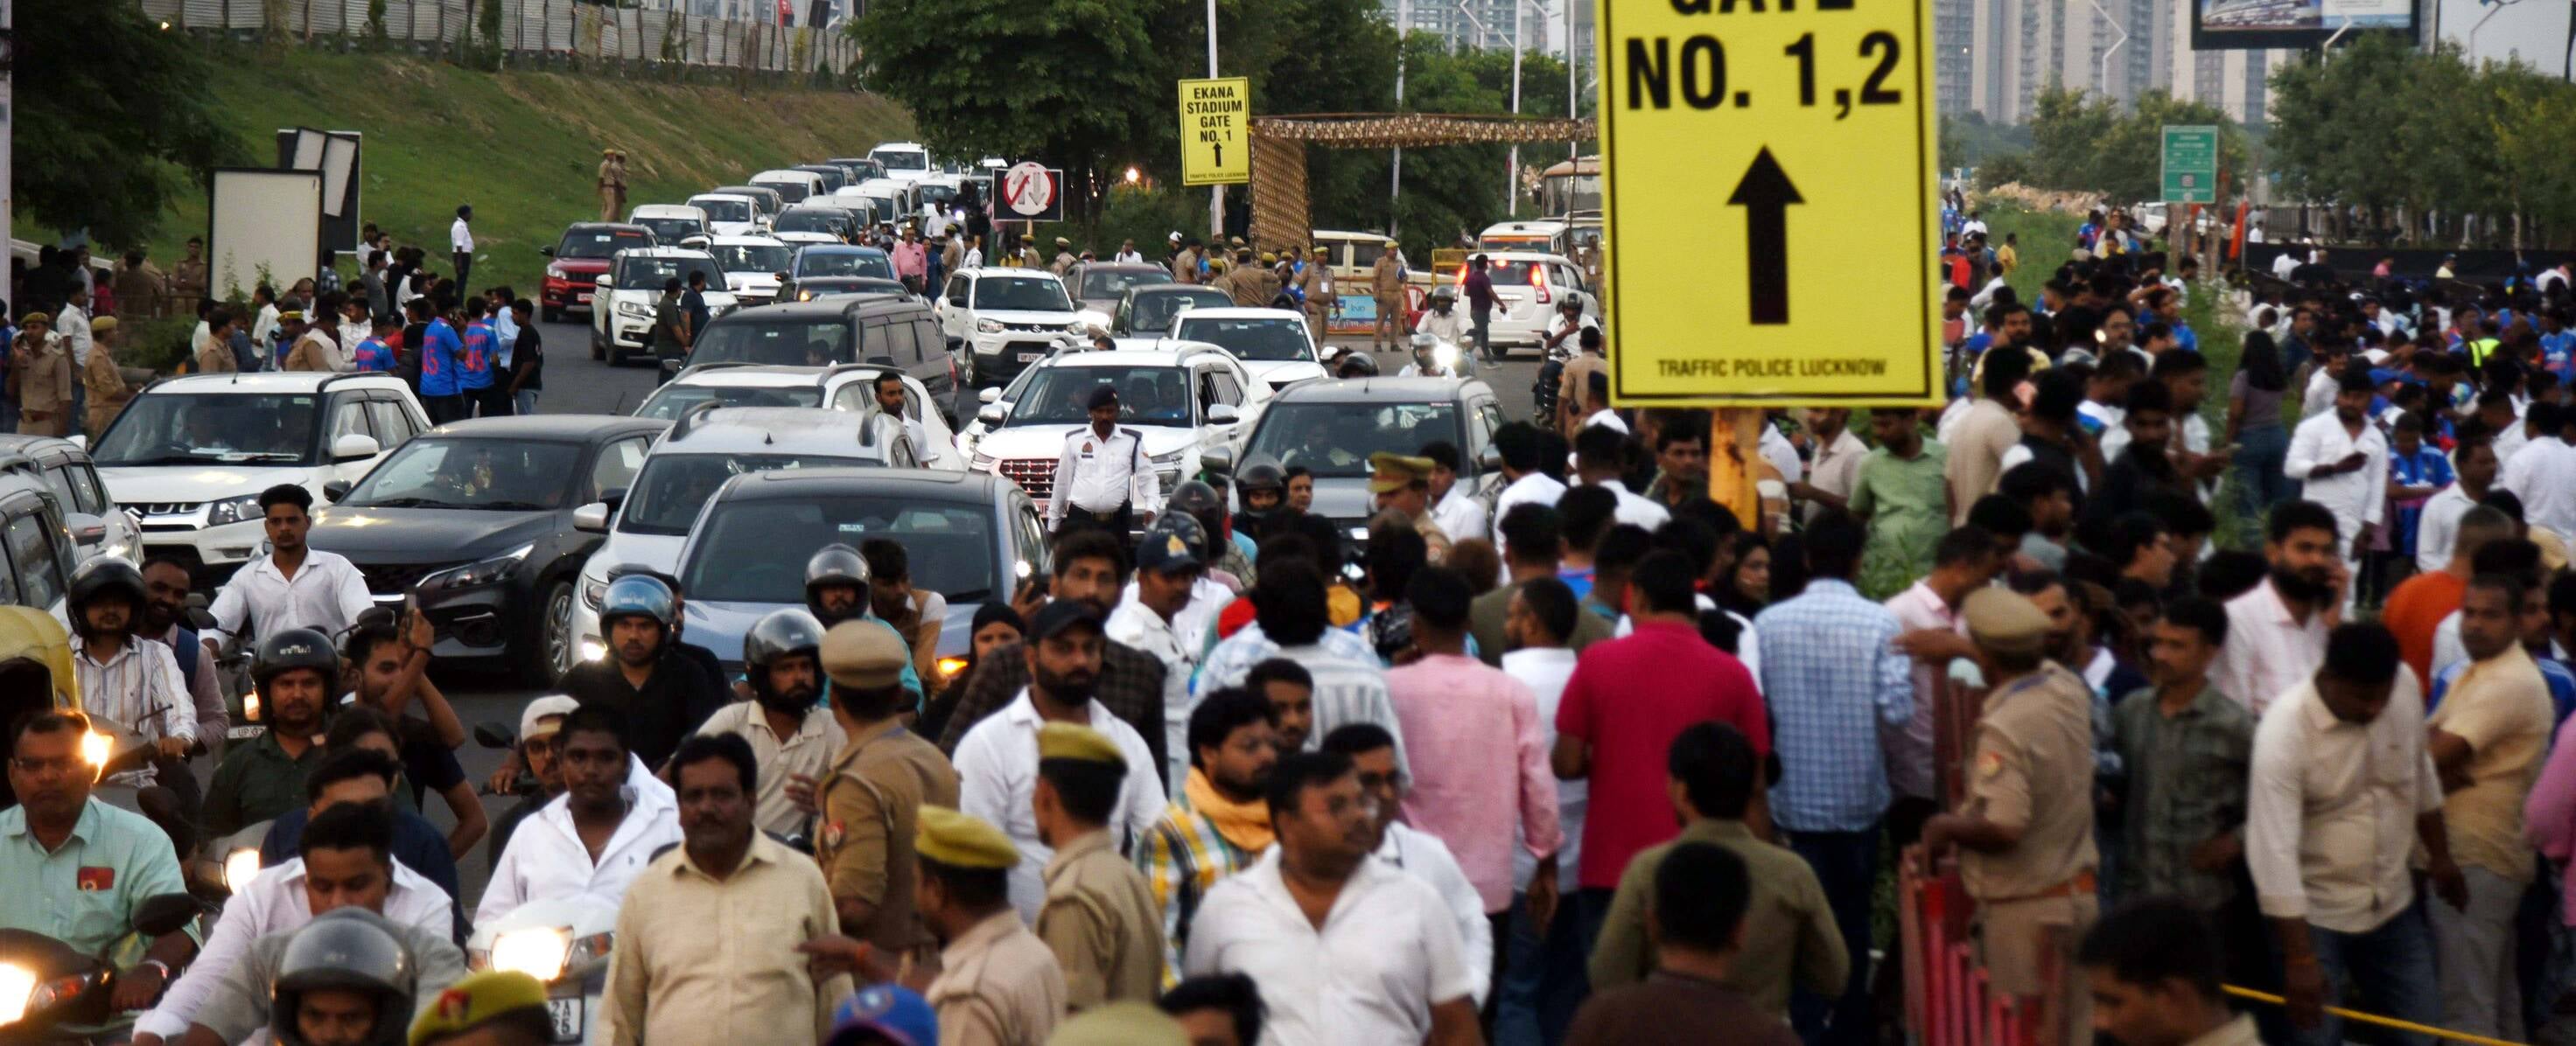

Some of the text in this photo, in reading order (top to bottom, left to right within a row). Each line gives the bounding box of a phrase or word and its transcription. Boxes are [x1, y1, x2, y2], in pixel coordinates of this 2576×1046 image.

[1626, 30, 1902, 121] NO. 1,2
[1194, 86, 1235, 100] EKANA
[1186, 100, 1242, 114] STADIUM
[1200, 115, 1231, 129] GATE
[1200, 129, 1232, 143] NO. 1
[1657, 359, 1887, 377] TRAFFIC POLICE LUCKNOW
